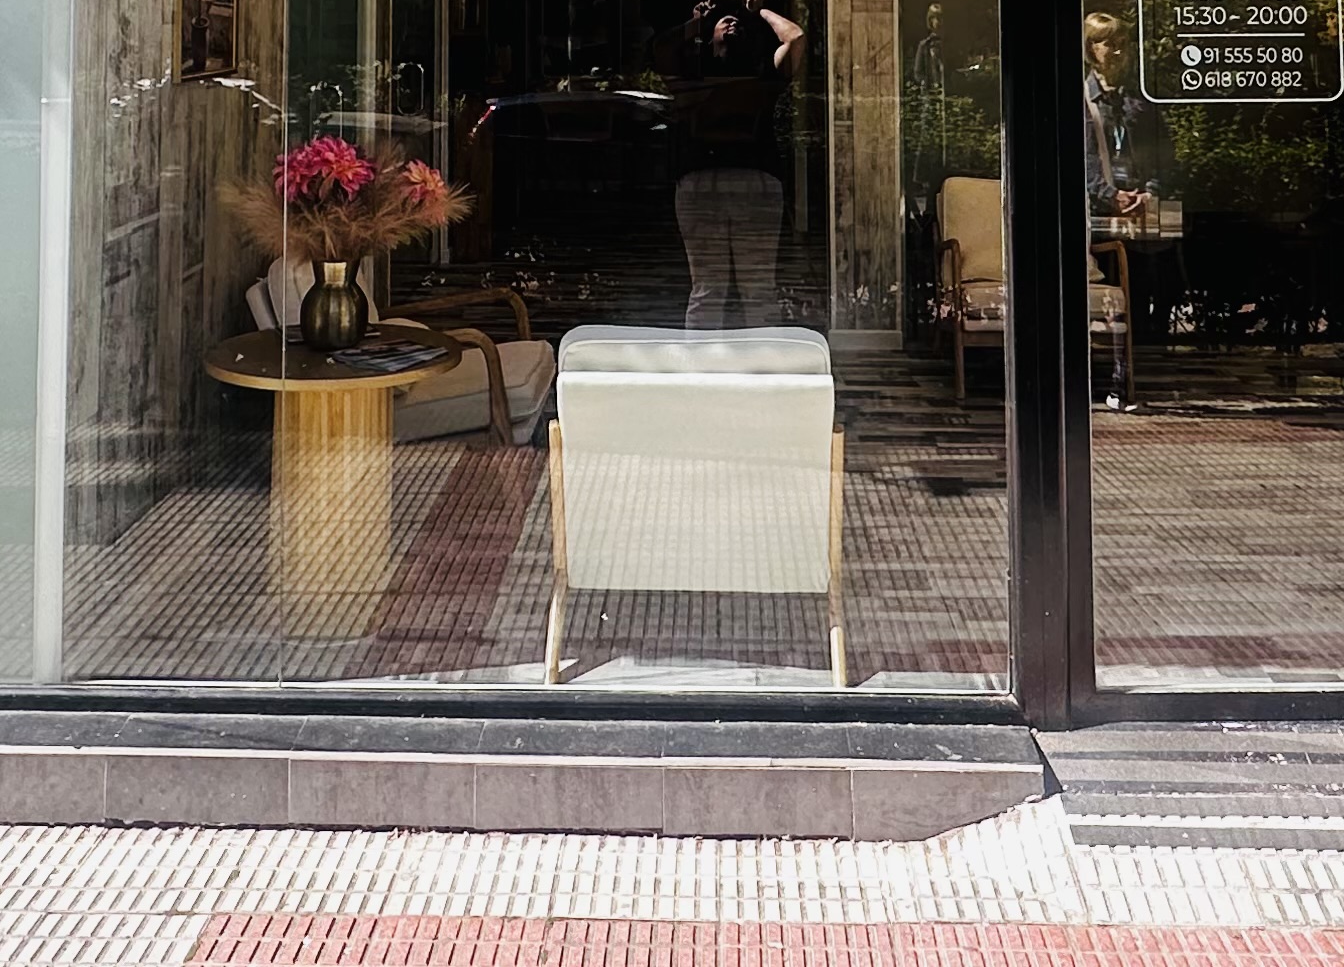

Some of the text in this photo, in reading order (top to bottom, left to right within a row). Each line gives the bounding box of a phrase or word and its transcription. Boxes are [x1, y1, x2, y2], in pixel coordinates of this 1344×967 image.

[1173, 6, 1227, 26] 15:30
[1246, 6, 1308, 25] 20:00
[1203, 47, 1304, 64] 91 555 50 80
[1204, 71, 1303, 88] 618 670 882
